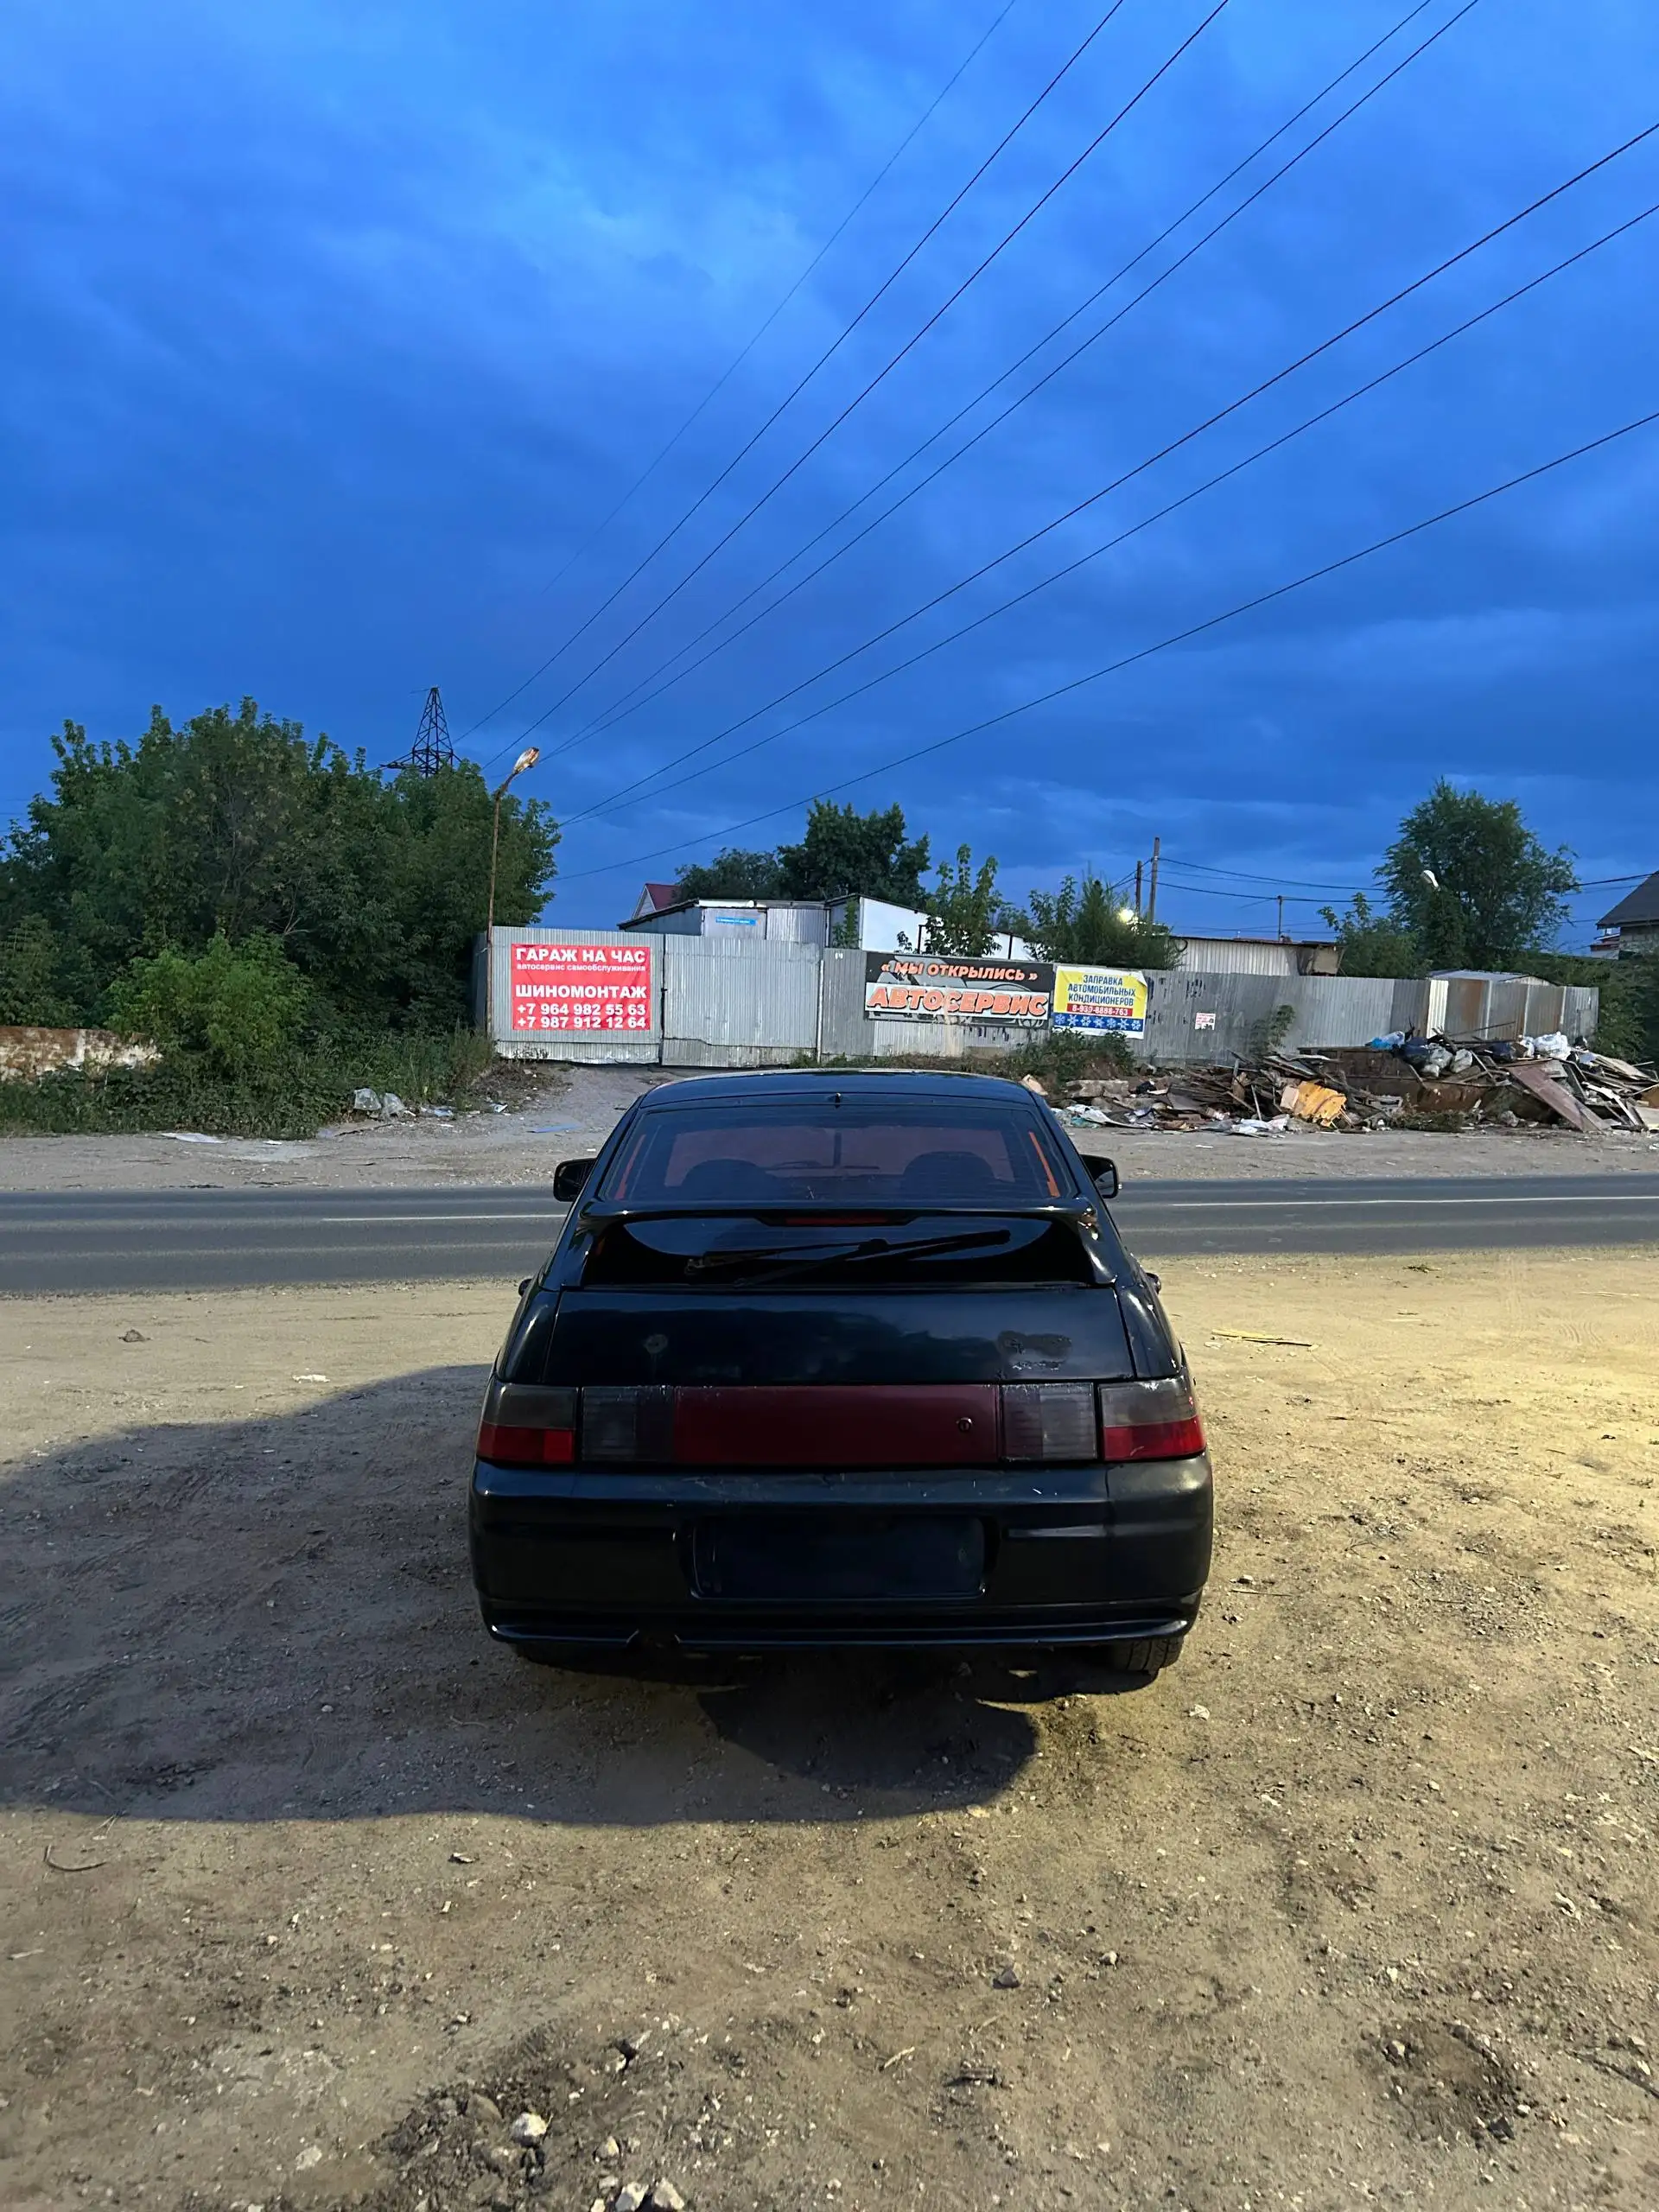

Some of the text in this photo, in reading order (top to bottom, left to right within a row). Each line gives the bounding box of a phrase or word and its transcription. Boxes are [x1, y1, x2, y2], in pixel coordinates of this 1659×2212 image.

[516, 948, 645, 963] ГАРАЖ НА ЧАС
[517, 963, 646, 973] автосервис самообслуживания
[895, 962, 924, 975] МЫ
[927, 963, 1026, 982] ОТКРЫЛИСЬ
[1084, 975, 1123, 986] ЗАПРАВКА
[516, 984, 647, 999] ШИНОМОНТАЖ
[1068, 983, 1136, 997] АВТОМОБИЛЬНЫХ
[867, 987, 1049, 1017] АВТОСЕРВИС
[1068, 994, 1134, 1006] КОНДИЦИОНЕРОВ
[518, 1003, 646, 1015] +7 964 982 55 63
[518, 1017, 646, 1028] +7 987 912 12 64
